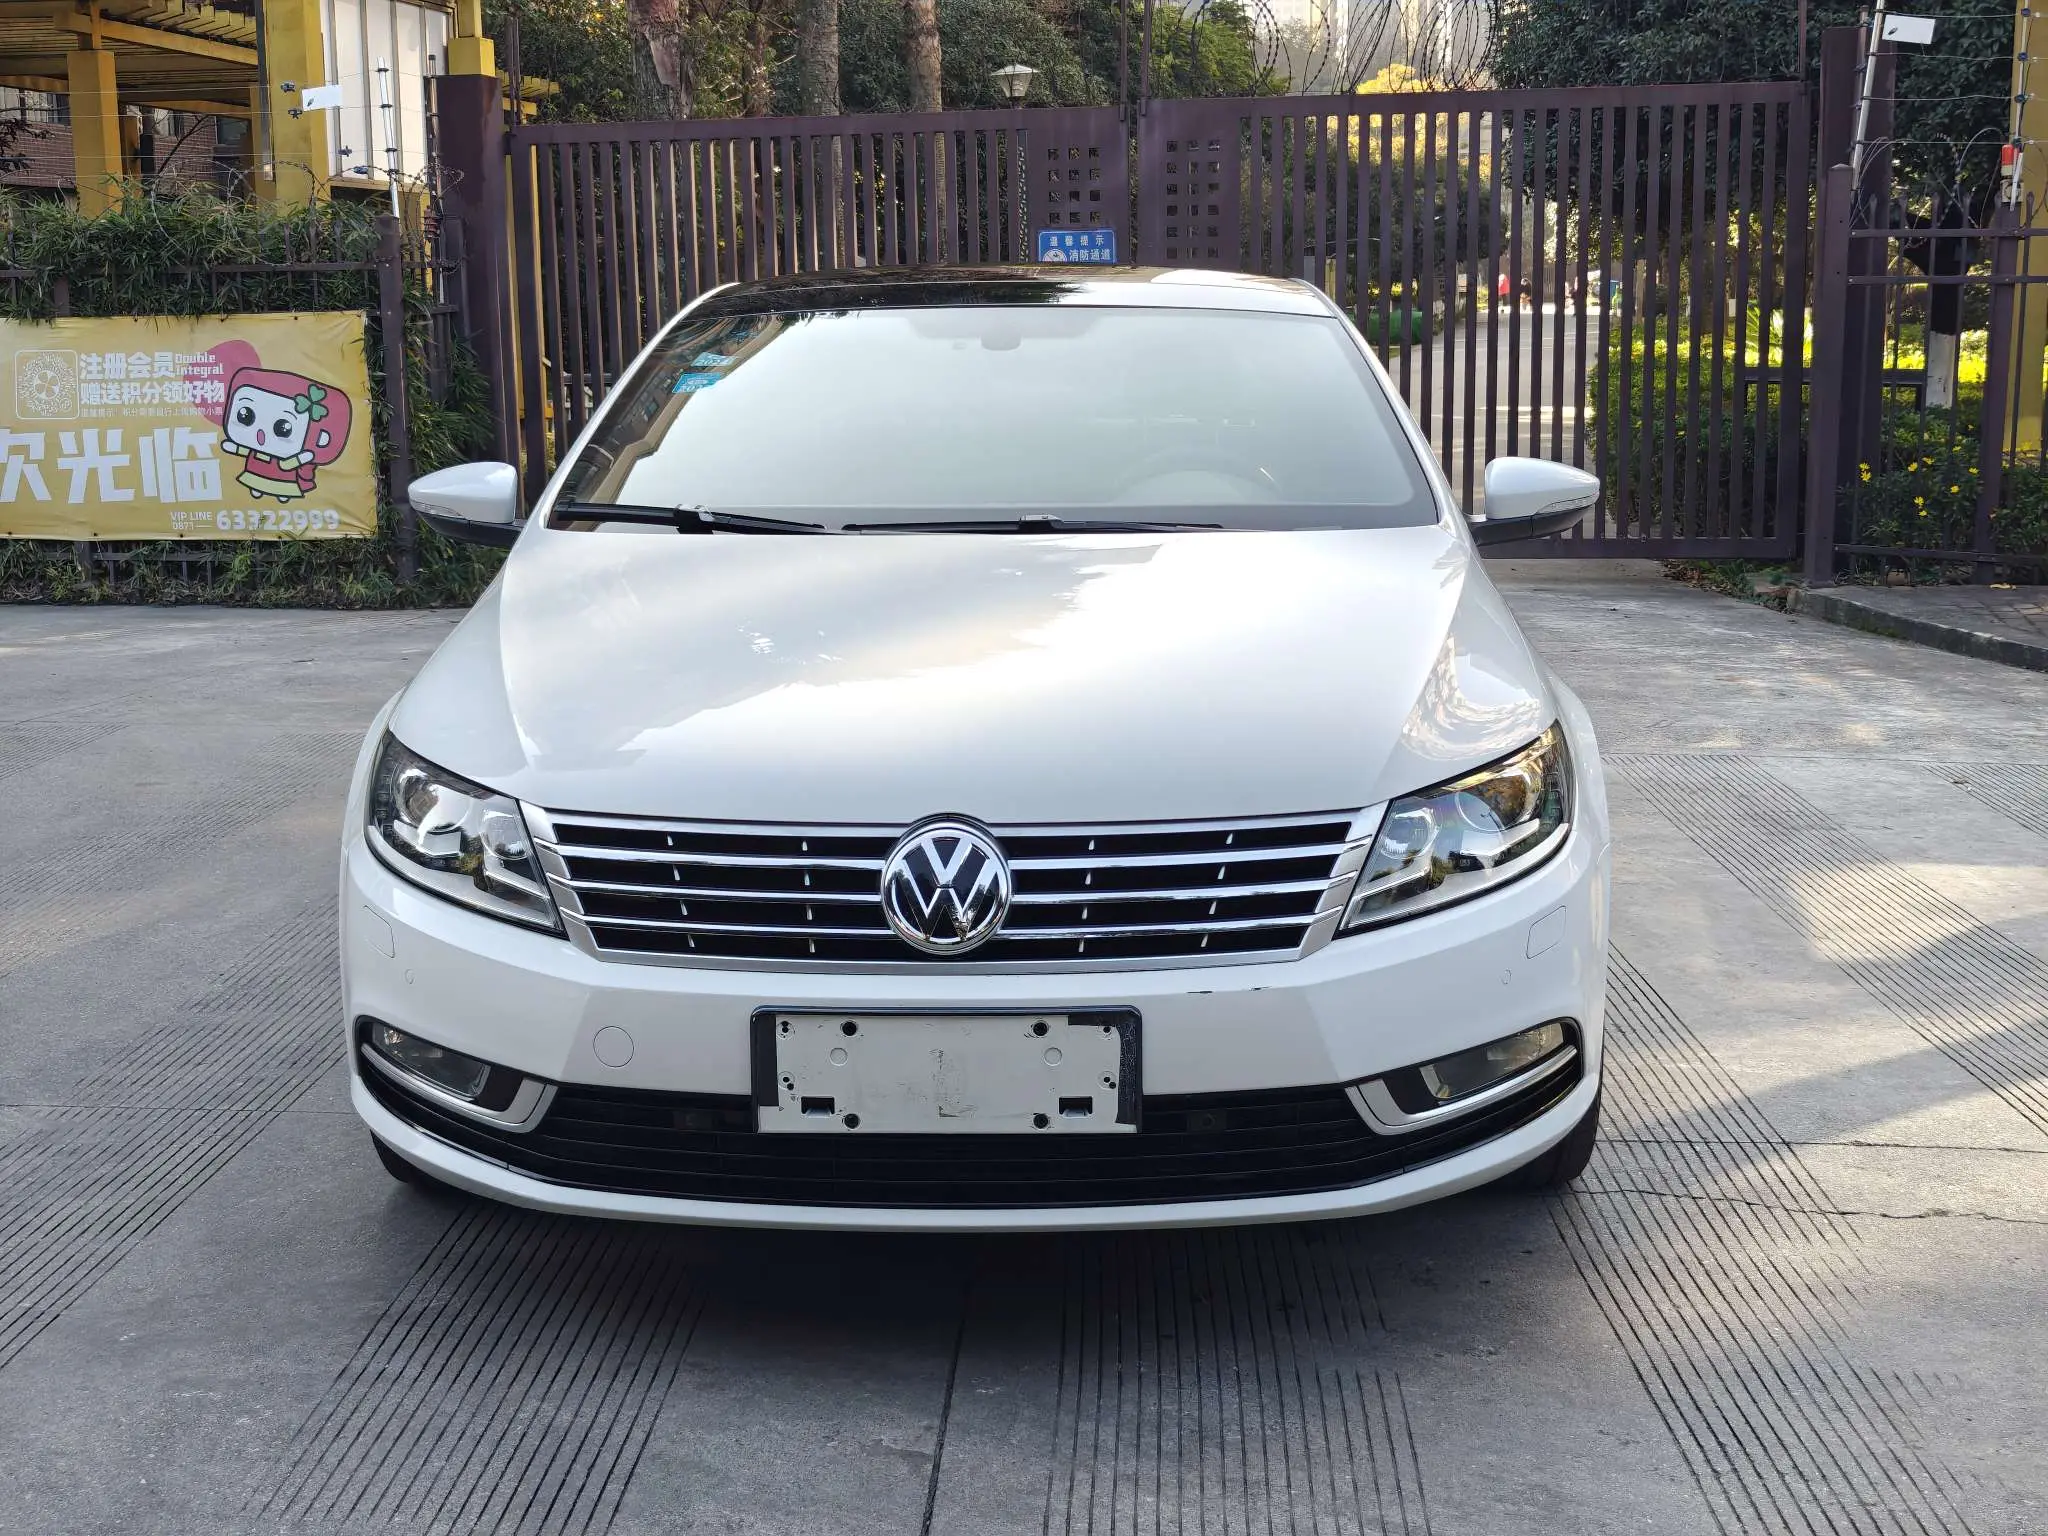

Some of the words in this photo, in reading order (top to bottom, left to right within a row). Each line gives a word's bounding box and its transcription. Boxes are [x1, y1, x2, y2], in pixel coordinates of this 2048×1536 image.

[1069, 249, 1110, 261] 消防通道
[79, 351, 176, 380] 注册会员
[79, 381, 226, 405] 赠送积分领好物
[170, 511, 188, 521] VIP
[190, 511, 213, 521] LINE
[216, 509, 341, 531] 63322999
